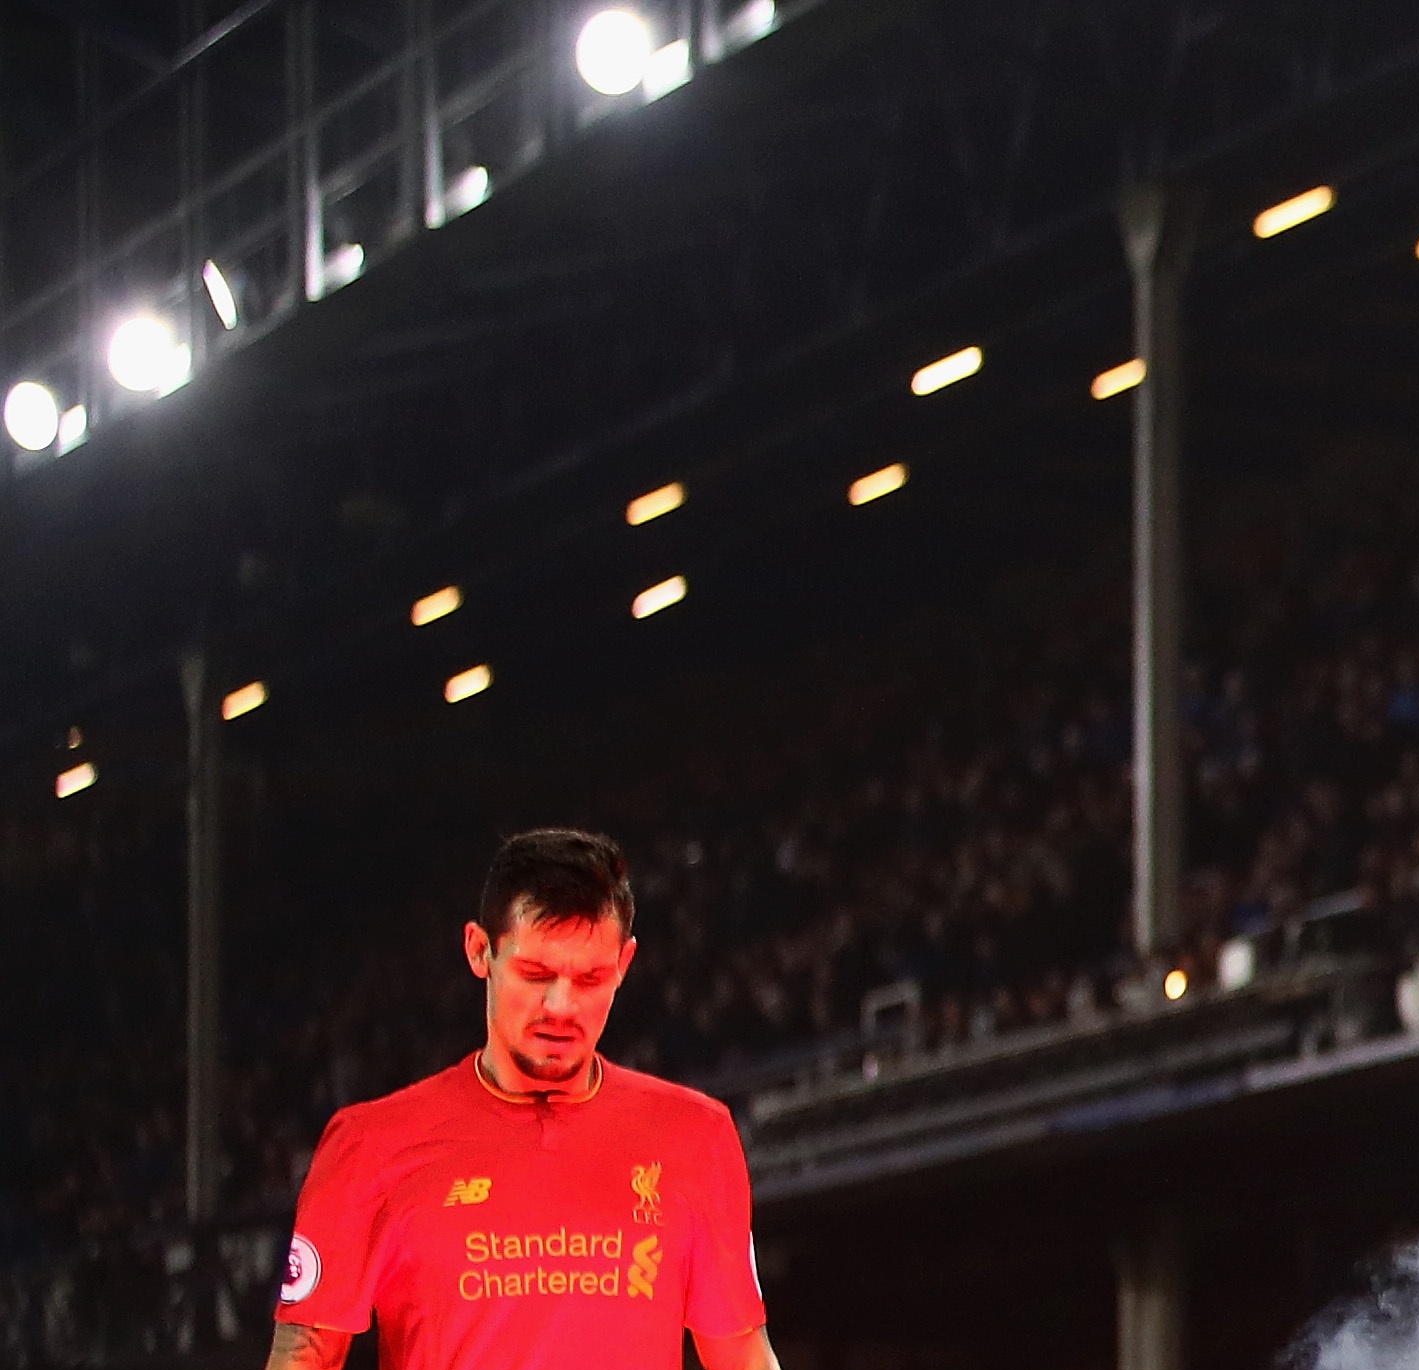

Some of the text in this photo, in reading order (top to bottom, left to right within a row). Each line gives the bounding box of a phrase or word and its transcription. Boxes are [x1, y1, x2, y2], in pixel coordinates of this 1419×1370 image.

[443, 1177, 493, 1207] NB
[632, 1208, 664, 1226] LFC
[465, 1226, 622, 1263] Standard
[458, 1266, 620, 1301] Chartered
